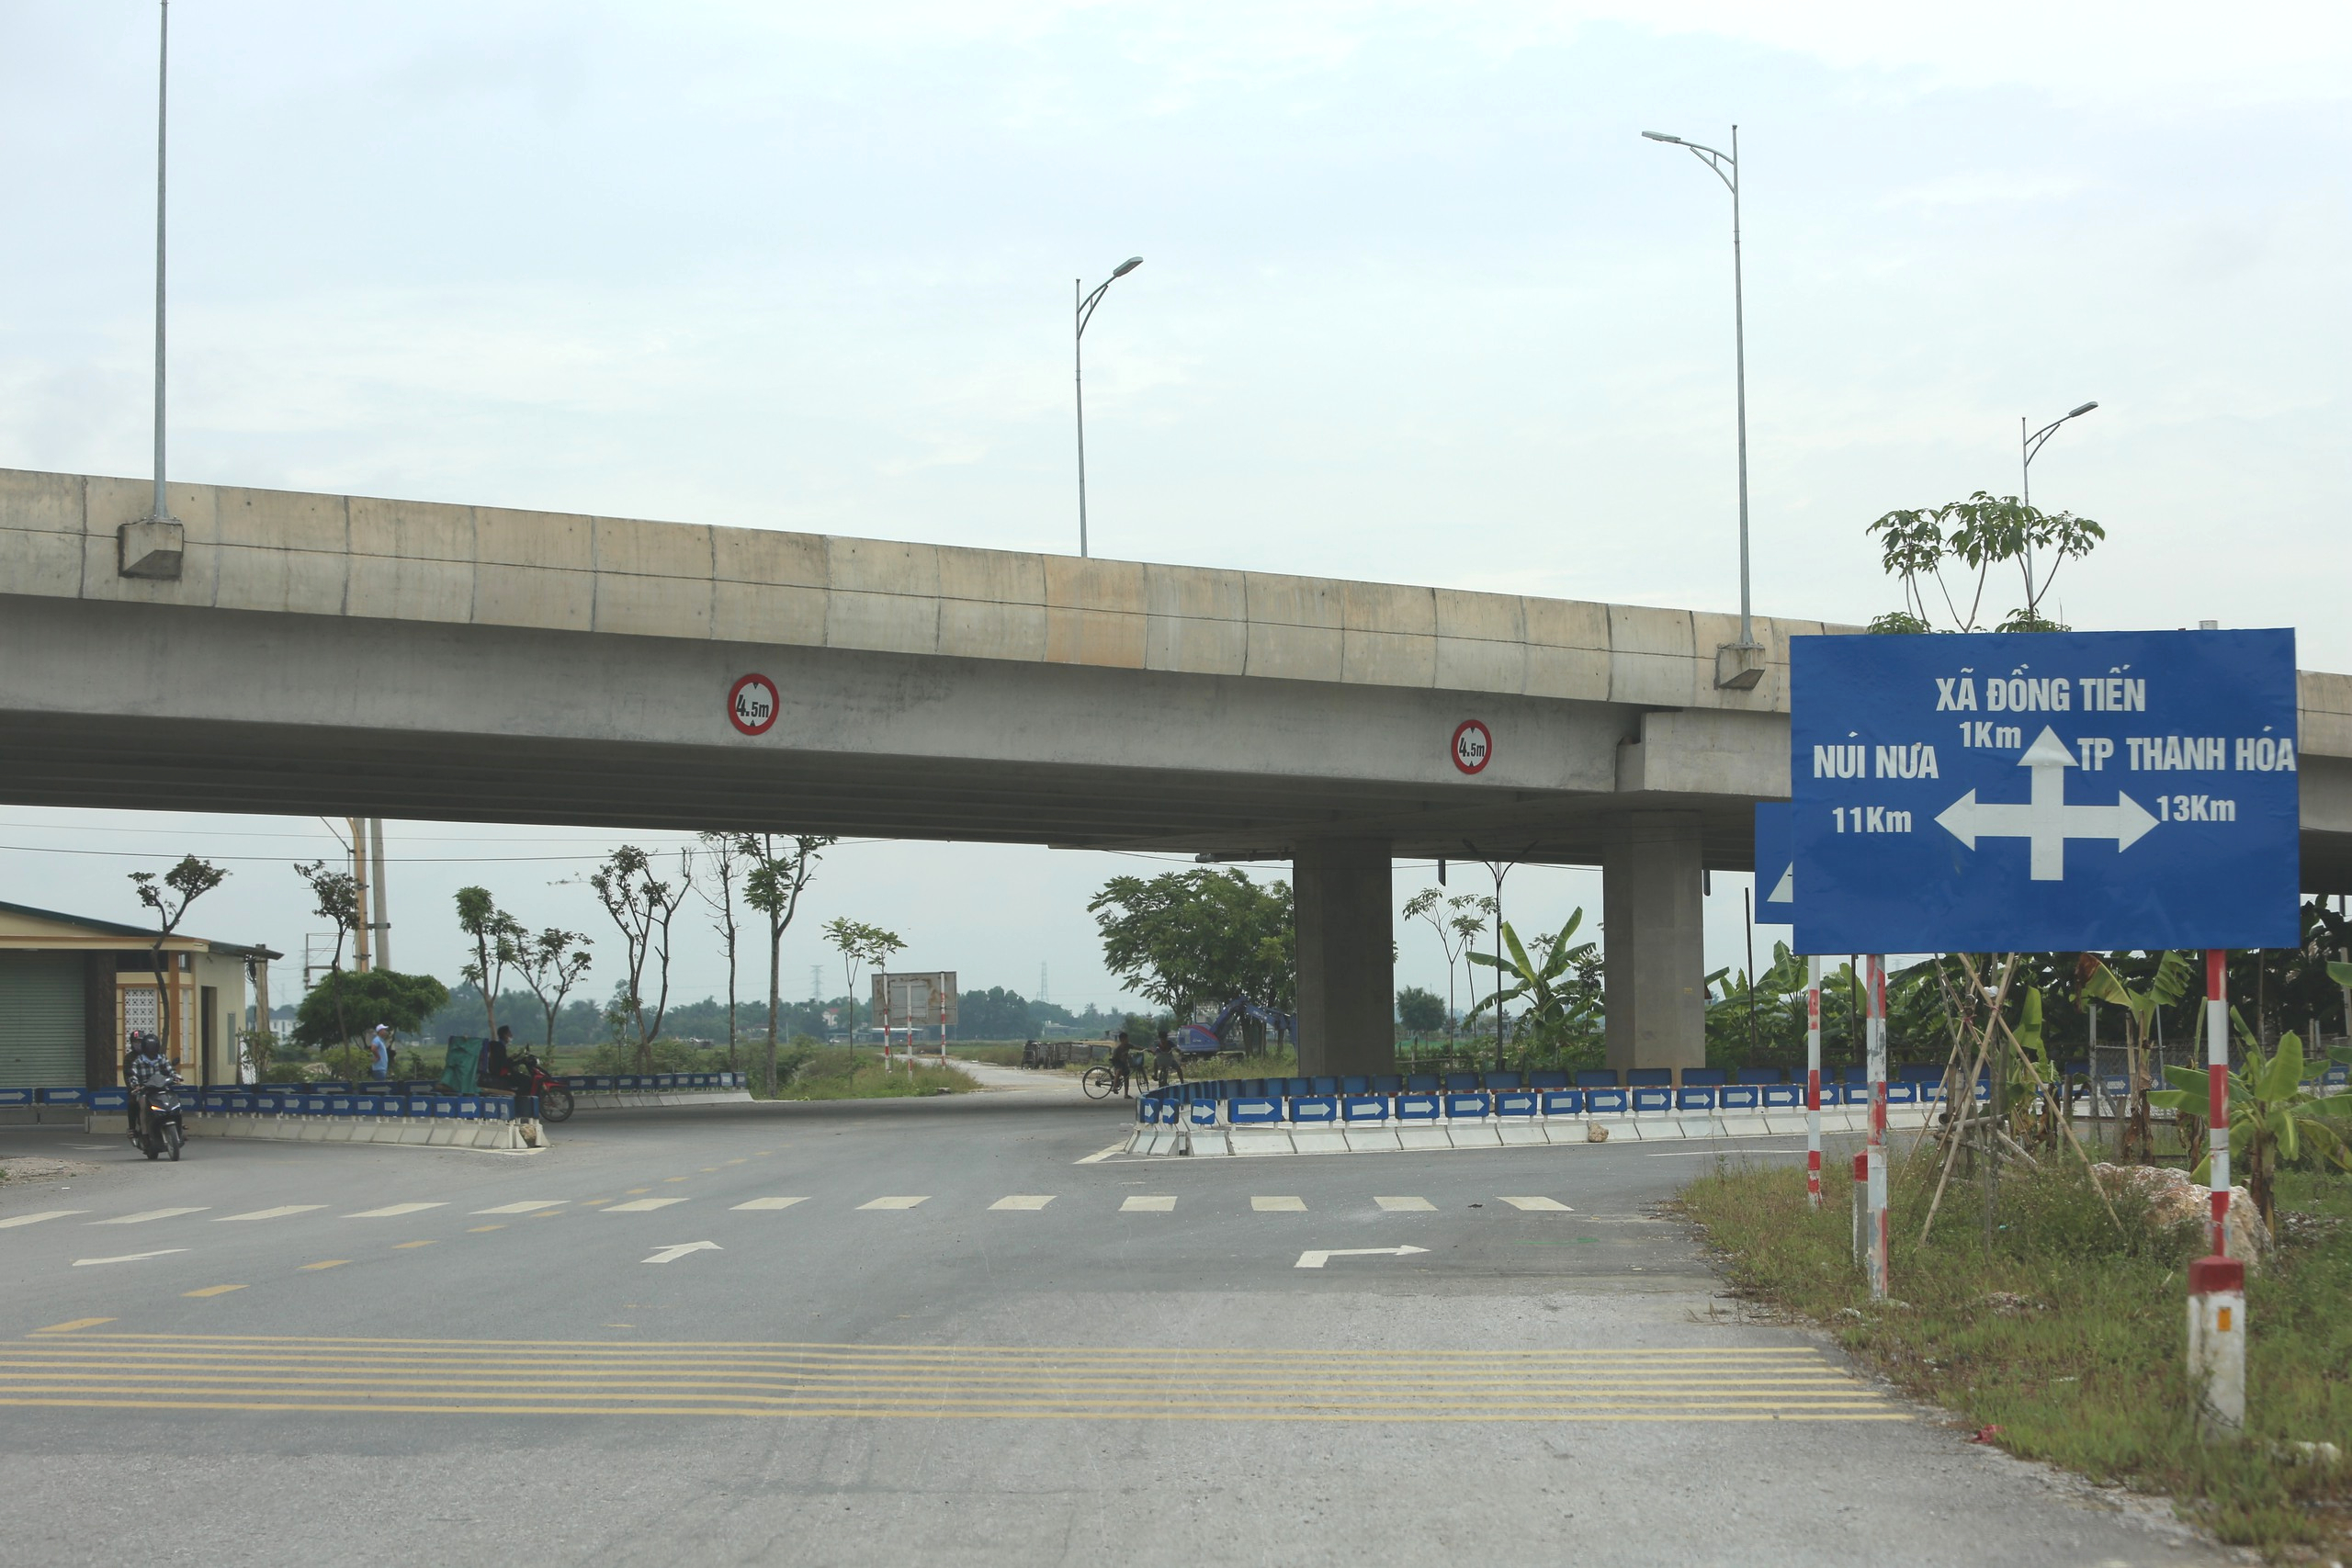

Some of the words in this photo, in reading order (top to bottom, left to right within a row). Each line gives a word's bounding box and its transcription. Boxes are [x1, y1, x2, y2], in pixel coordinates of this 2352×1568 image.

[1935, 667, 1978, 712] XÃ
[1986, 663, 2070, 712] ĐỒNG
[2079, 664, 2145, 712] TIẾN
[736, 694, 770, 718] 4.5m
[1459, 737, 1486, 758] 4.5m
[1959, 721, 2021, 749] 1Km
[1814, 731, 1866, 779] NÚI
[1875, 741, 1939, 779] NƯA
[2076, 738, 2114, 771] TP
[2125, 735, 2225, 771] THANH
[2235, 726, 2297, 772] HÓA
[1832, 806, 1912, 833] 11Km
[2156, 795, 2236, 822] 13Km
